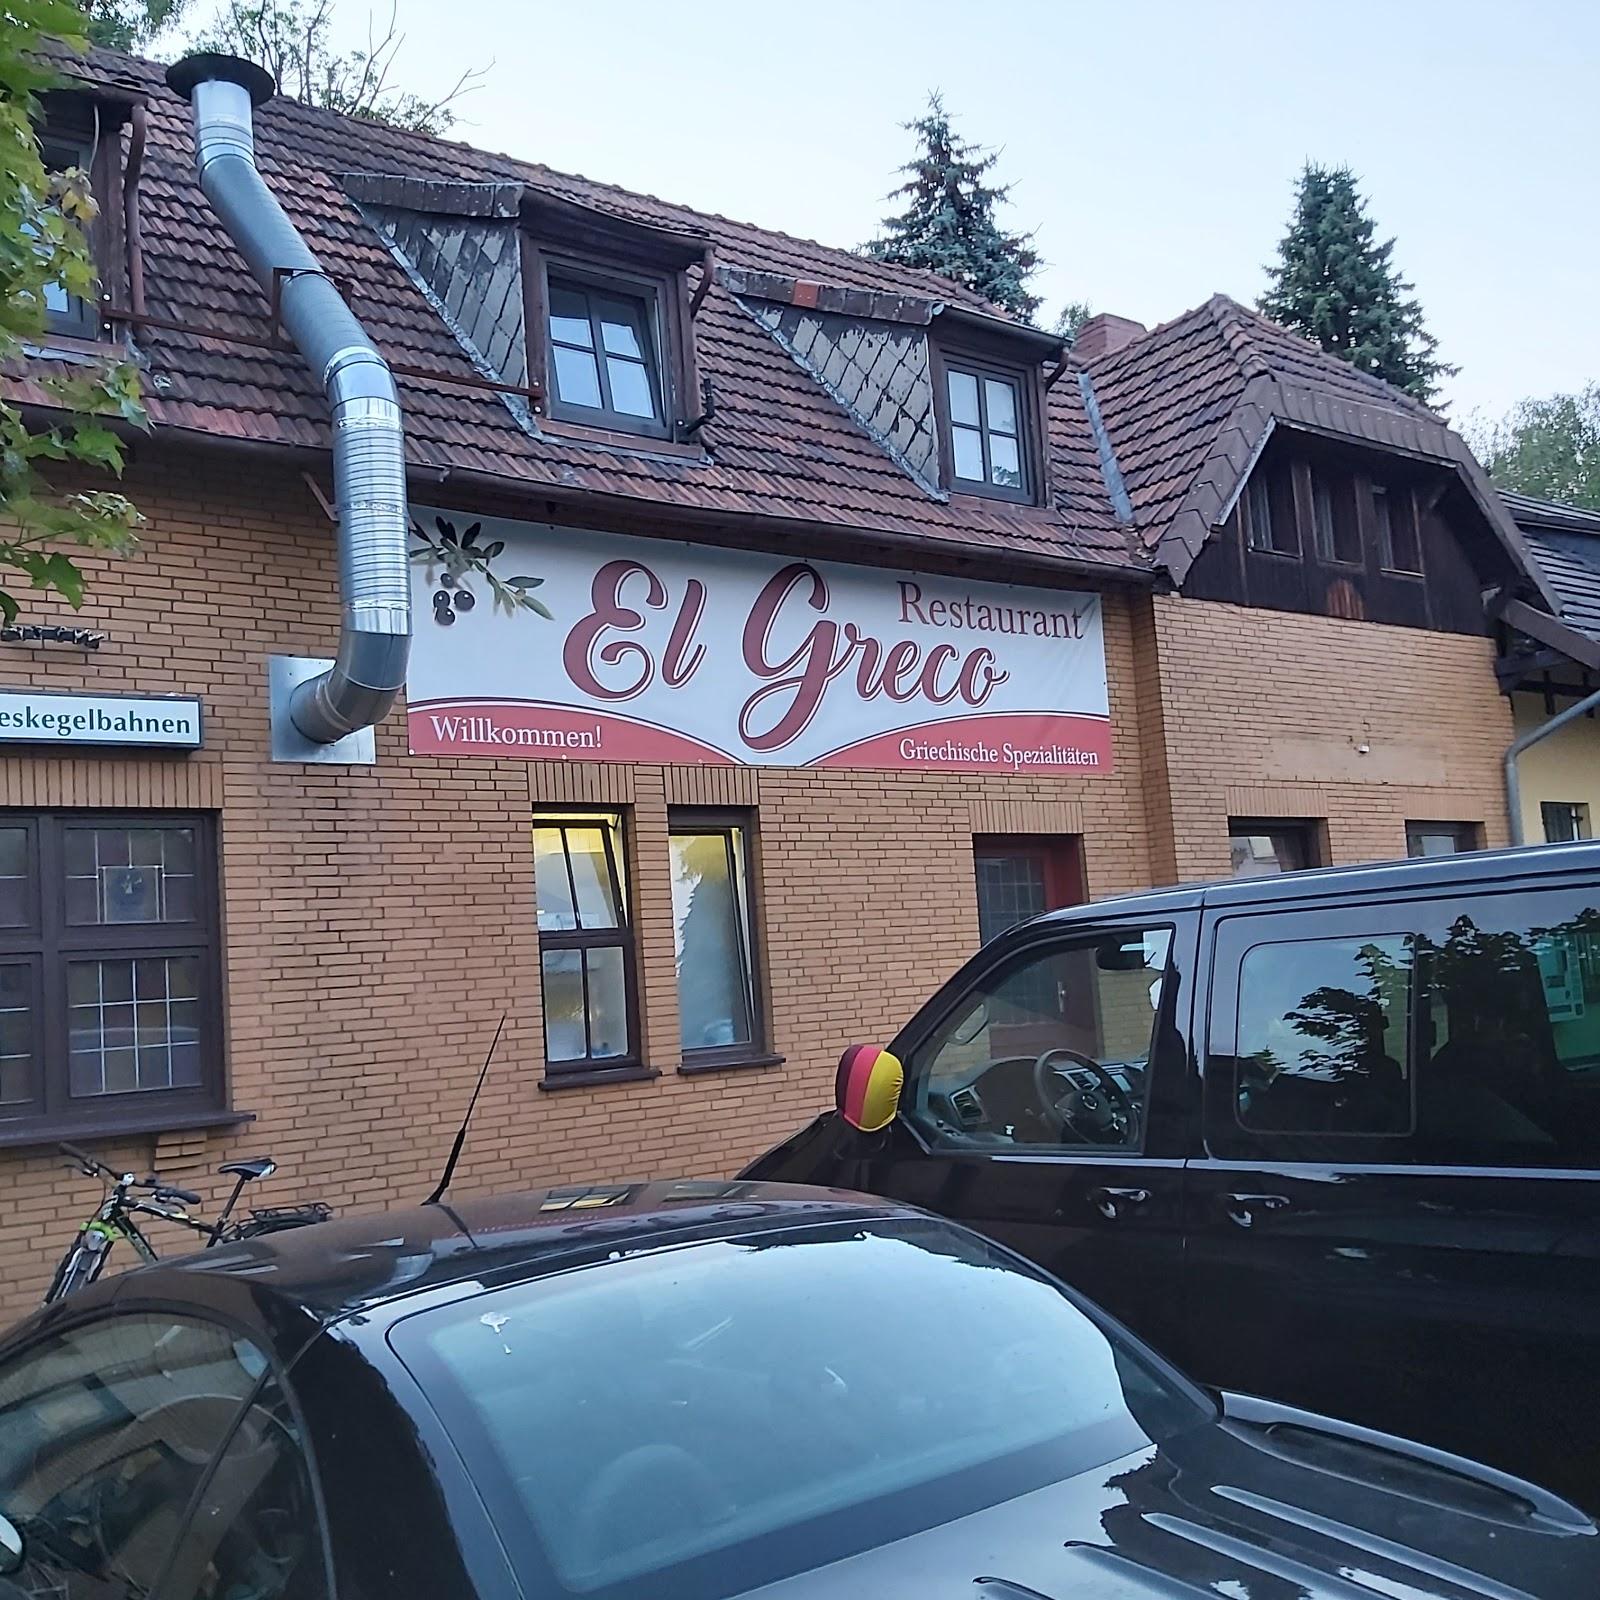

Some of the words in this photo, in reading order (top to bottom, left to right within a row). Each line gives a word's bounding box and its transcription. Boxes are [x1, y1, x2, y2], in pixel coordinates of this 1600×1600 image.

[897, 581, 1084, 639] Restaurant
[563, 559, 707, 702] El
[738, 562, 1010, 753] Greco
[0, 705, 190, 736] eskegelbahnen
[430, 715, 602, 748] Willkommen!
[900, 738, 999, 763] Griechische
[1003, 743, 1099, 770] Spezialitäten
